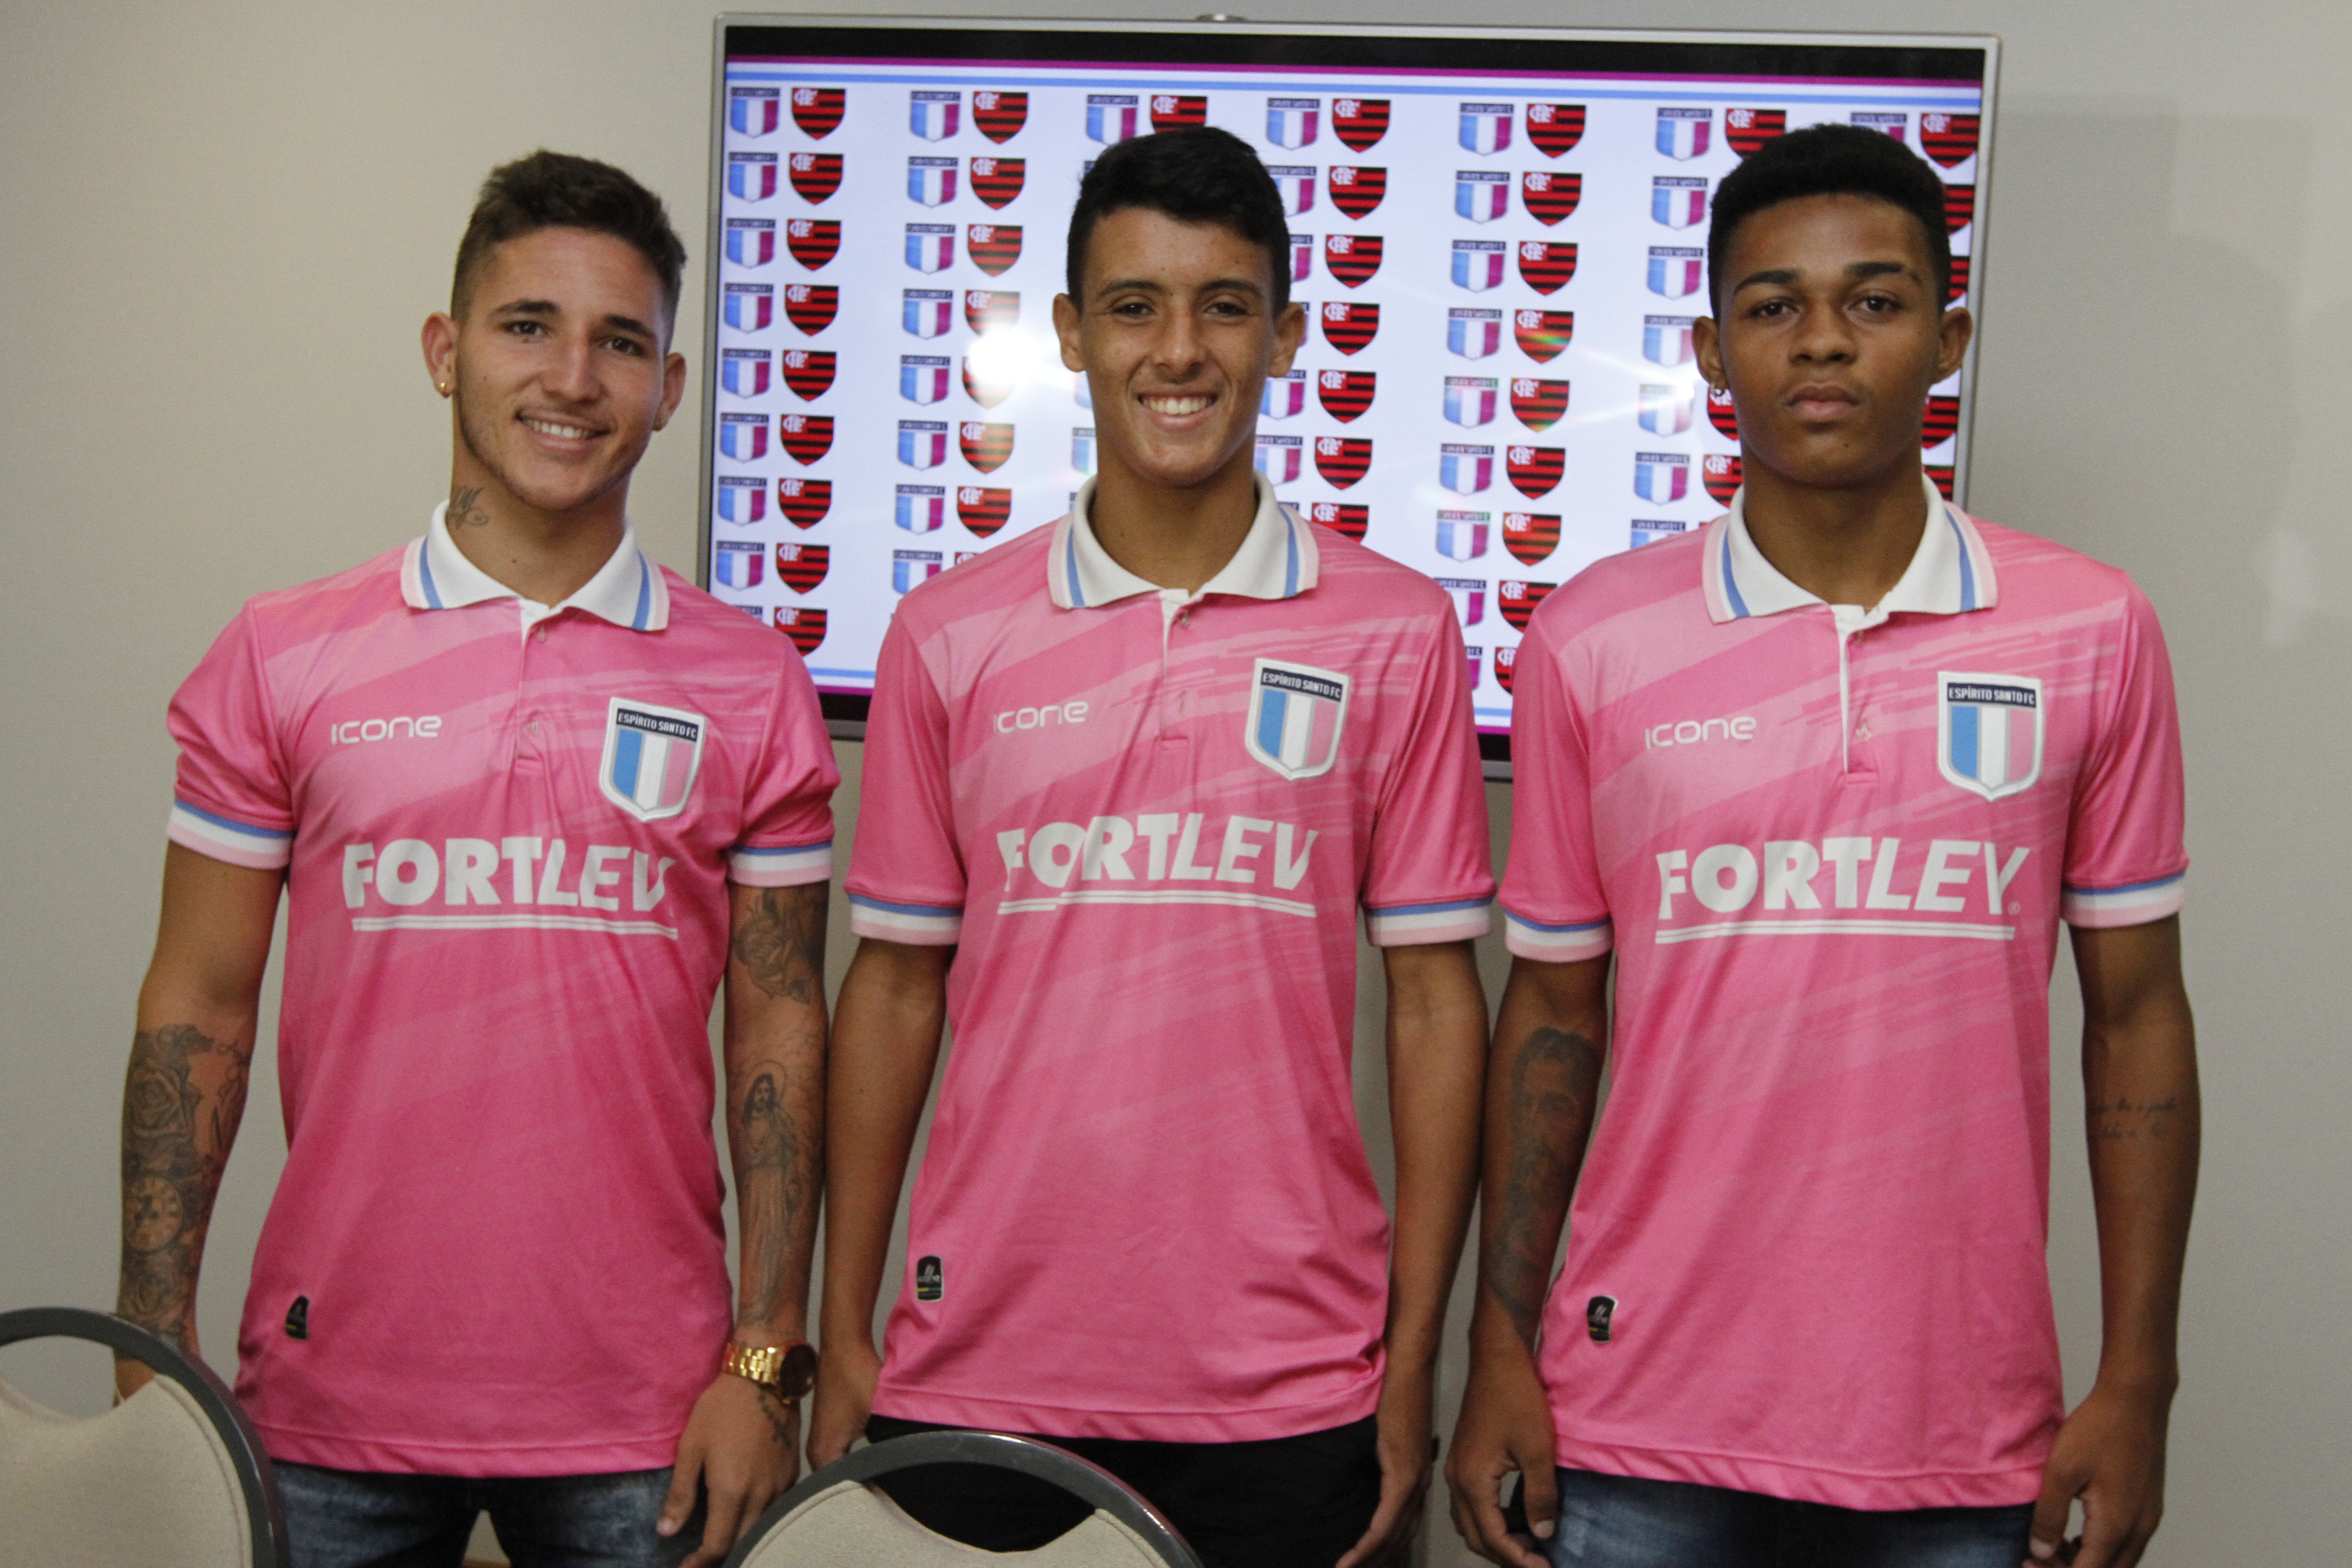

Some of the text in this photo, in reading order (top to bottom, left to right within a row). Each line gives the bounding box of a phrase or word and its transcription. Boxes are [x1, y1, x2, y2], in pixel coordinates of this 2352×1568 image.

[1262, 672, 1341, 698] ESPÍRITO SANTO FC
[1948, 685, 2035, 704] ESPÍRITO SANTO FC
[618, 712, 697, 738] ESPÍRITO SANTO FC
[996, 812, 1320, 892] FORTLEV
[342, 836, 676, 911] FORTLEV
